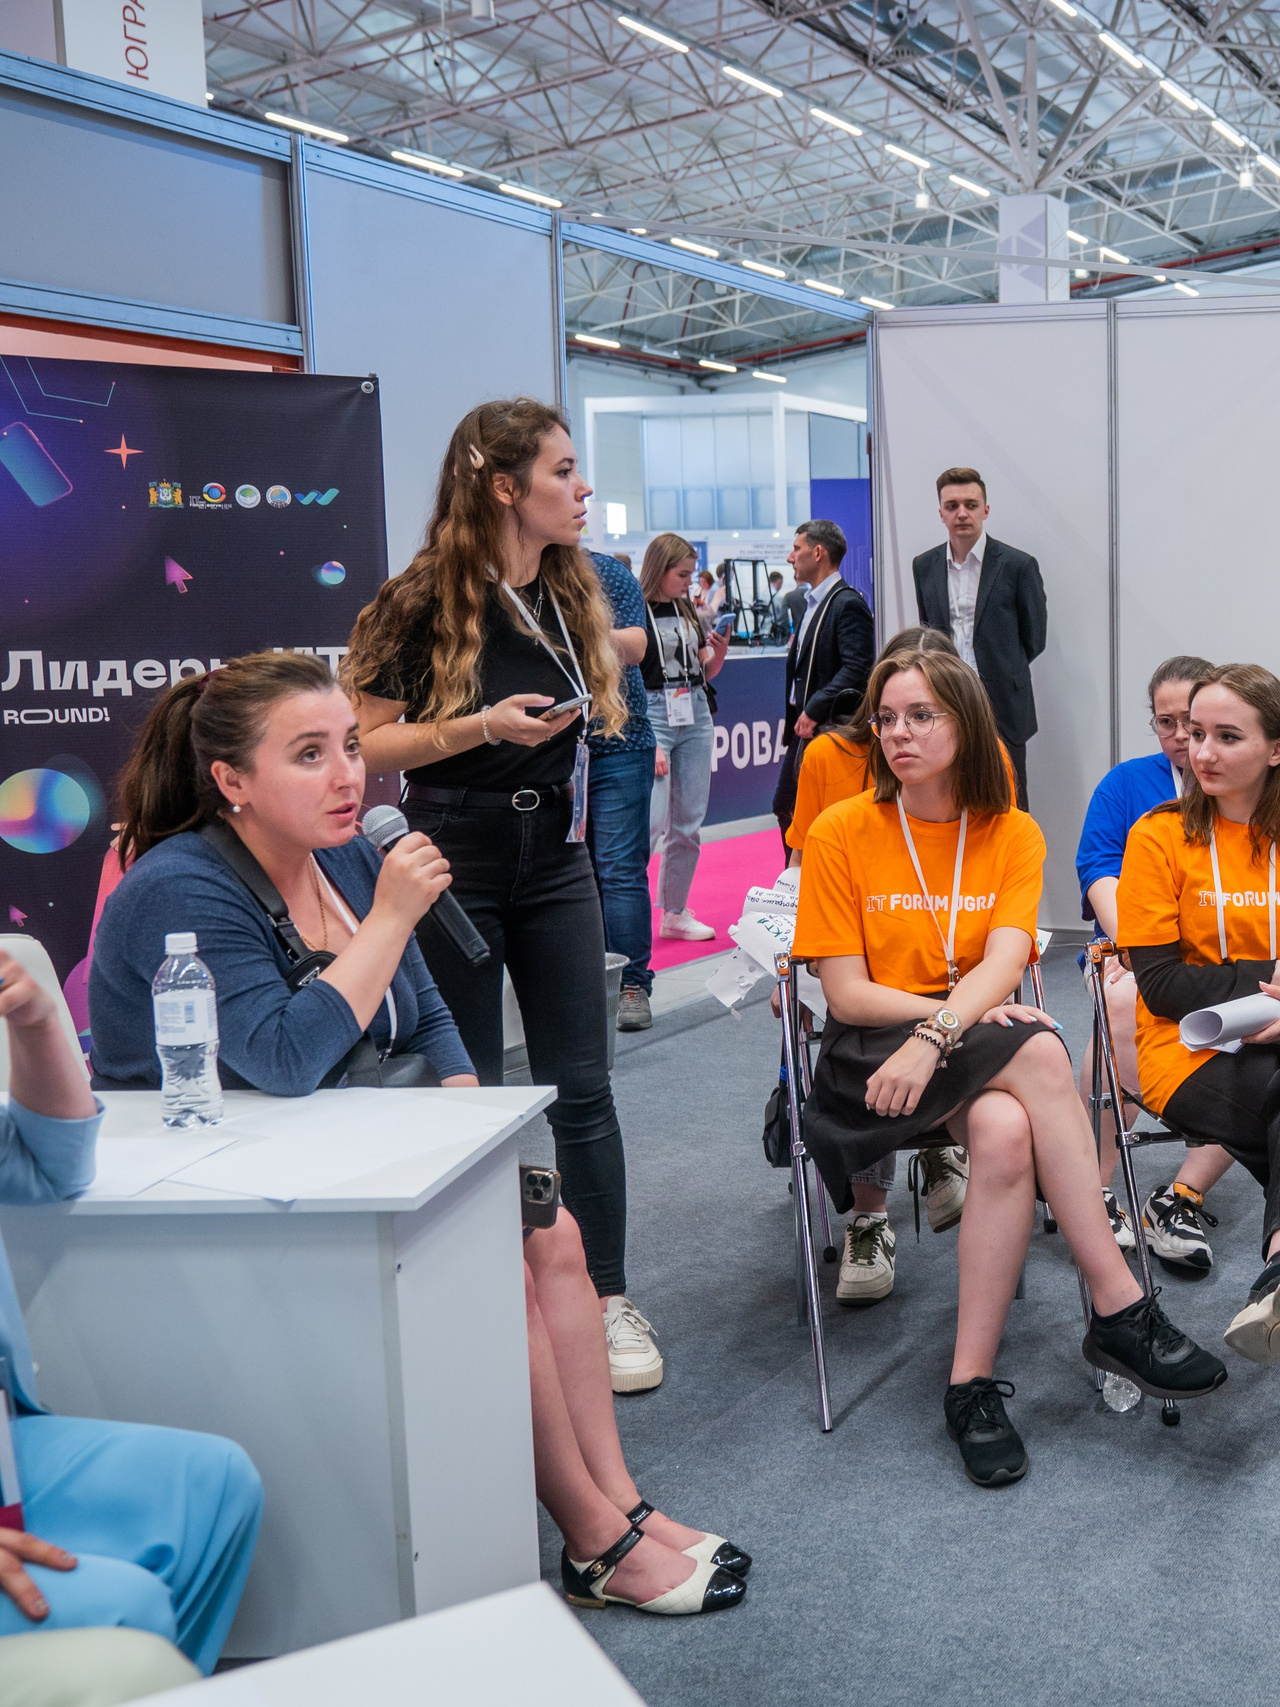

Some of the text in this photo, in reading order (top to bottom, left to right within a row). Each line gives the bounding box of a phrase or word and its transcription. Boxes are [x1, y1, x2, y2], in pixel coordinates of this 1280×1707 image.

[122, 0, 149, 80] ЮГР
[1, 650, 229, 697] Лидер
[3, 706, 110, 725] ROUND!
[867, 895, 886, 912] IT
[1199, 890, 1218, 907] IT
